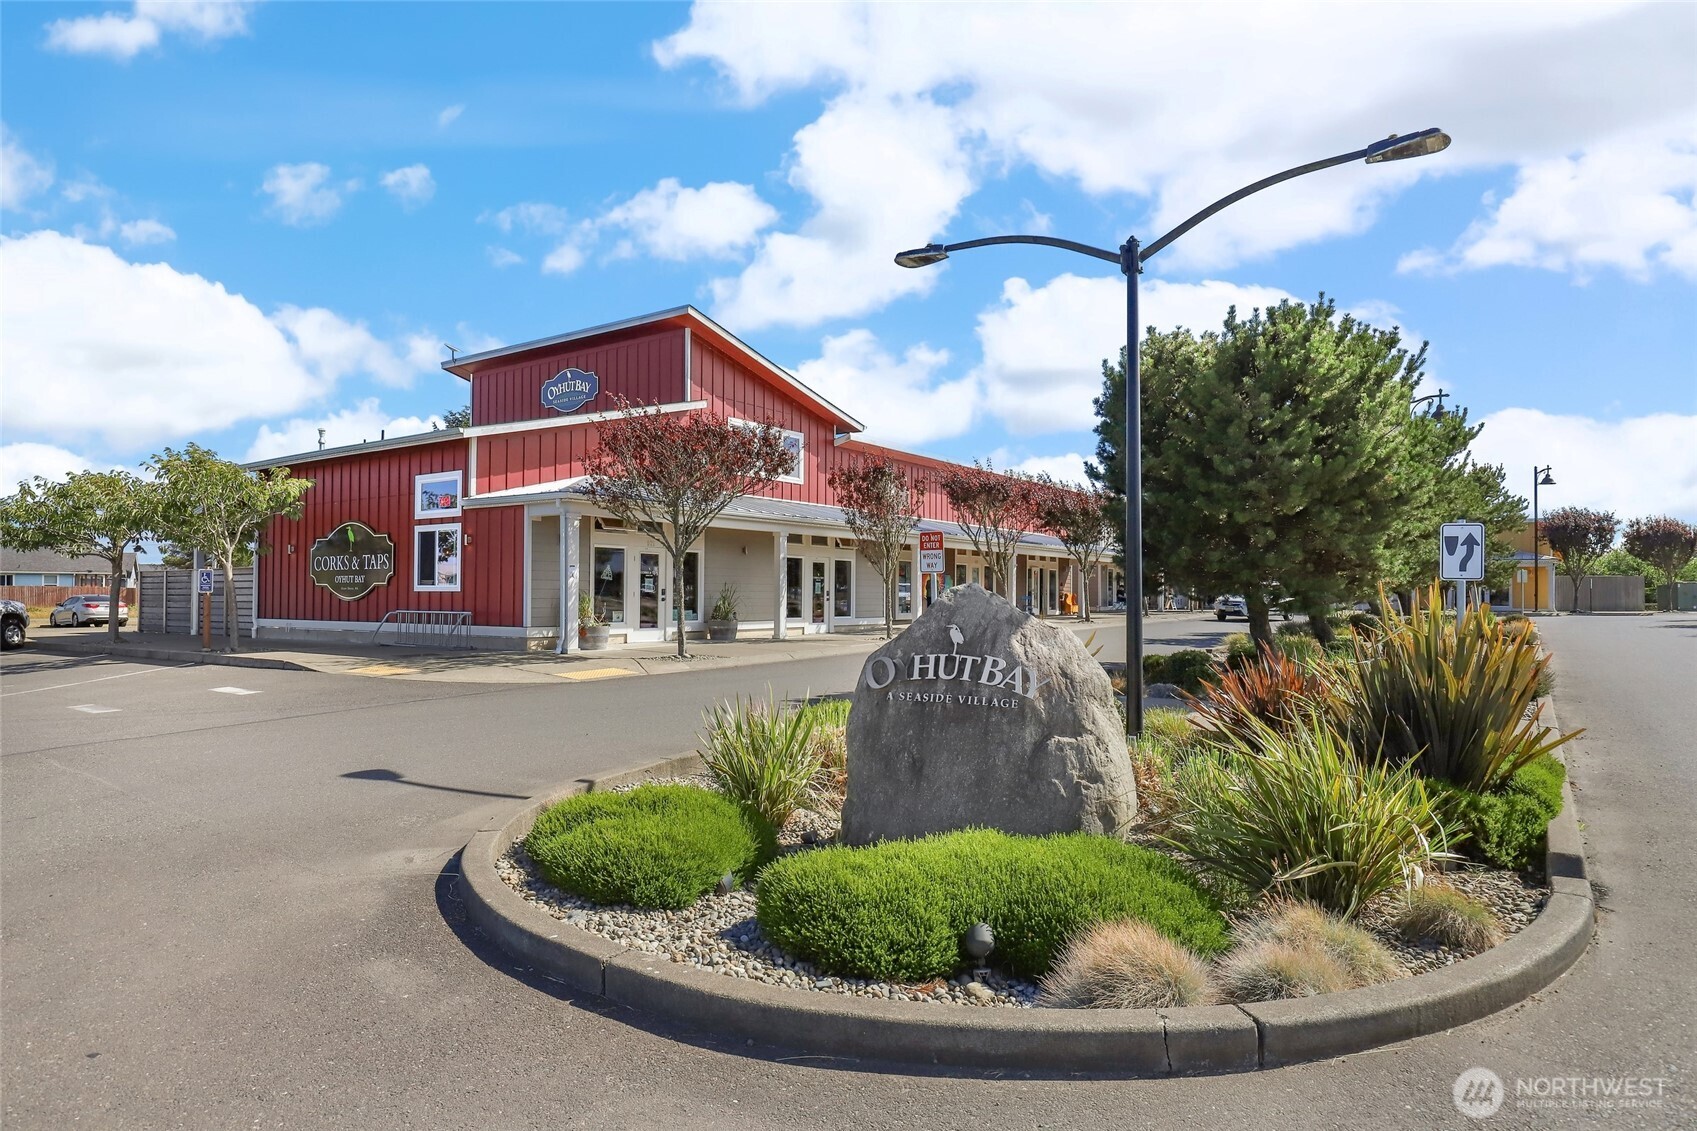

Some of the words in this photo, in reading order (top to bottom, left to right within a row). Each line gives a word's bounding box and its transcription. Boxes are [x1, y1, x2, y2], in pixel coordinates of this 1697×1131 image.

[930, 533, 941, 541] NOT
[923, 541, 940, 549] ENTER
[922, 552, 942, 560] WRONG
[314, 555, 349, 572] CORKS
[351, 556, 360, 570] &
[362, 553, 389, 570] TAPS
[335, 575, 354, 583] OYHUT
[354, 575, 365, 583] BAY
[886, 692, 894, 700] A
[899, 692, 952, 704] SEASIDE
[959, 695, 1019, 709] VILLAGE
